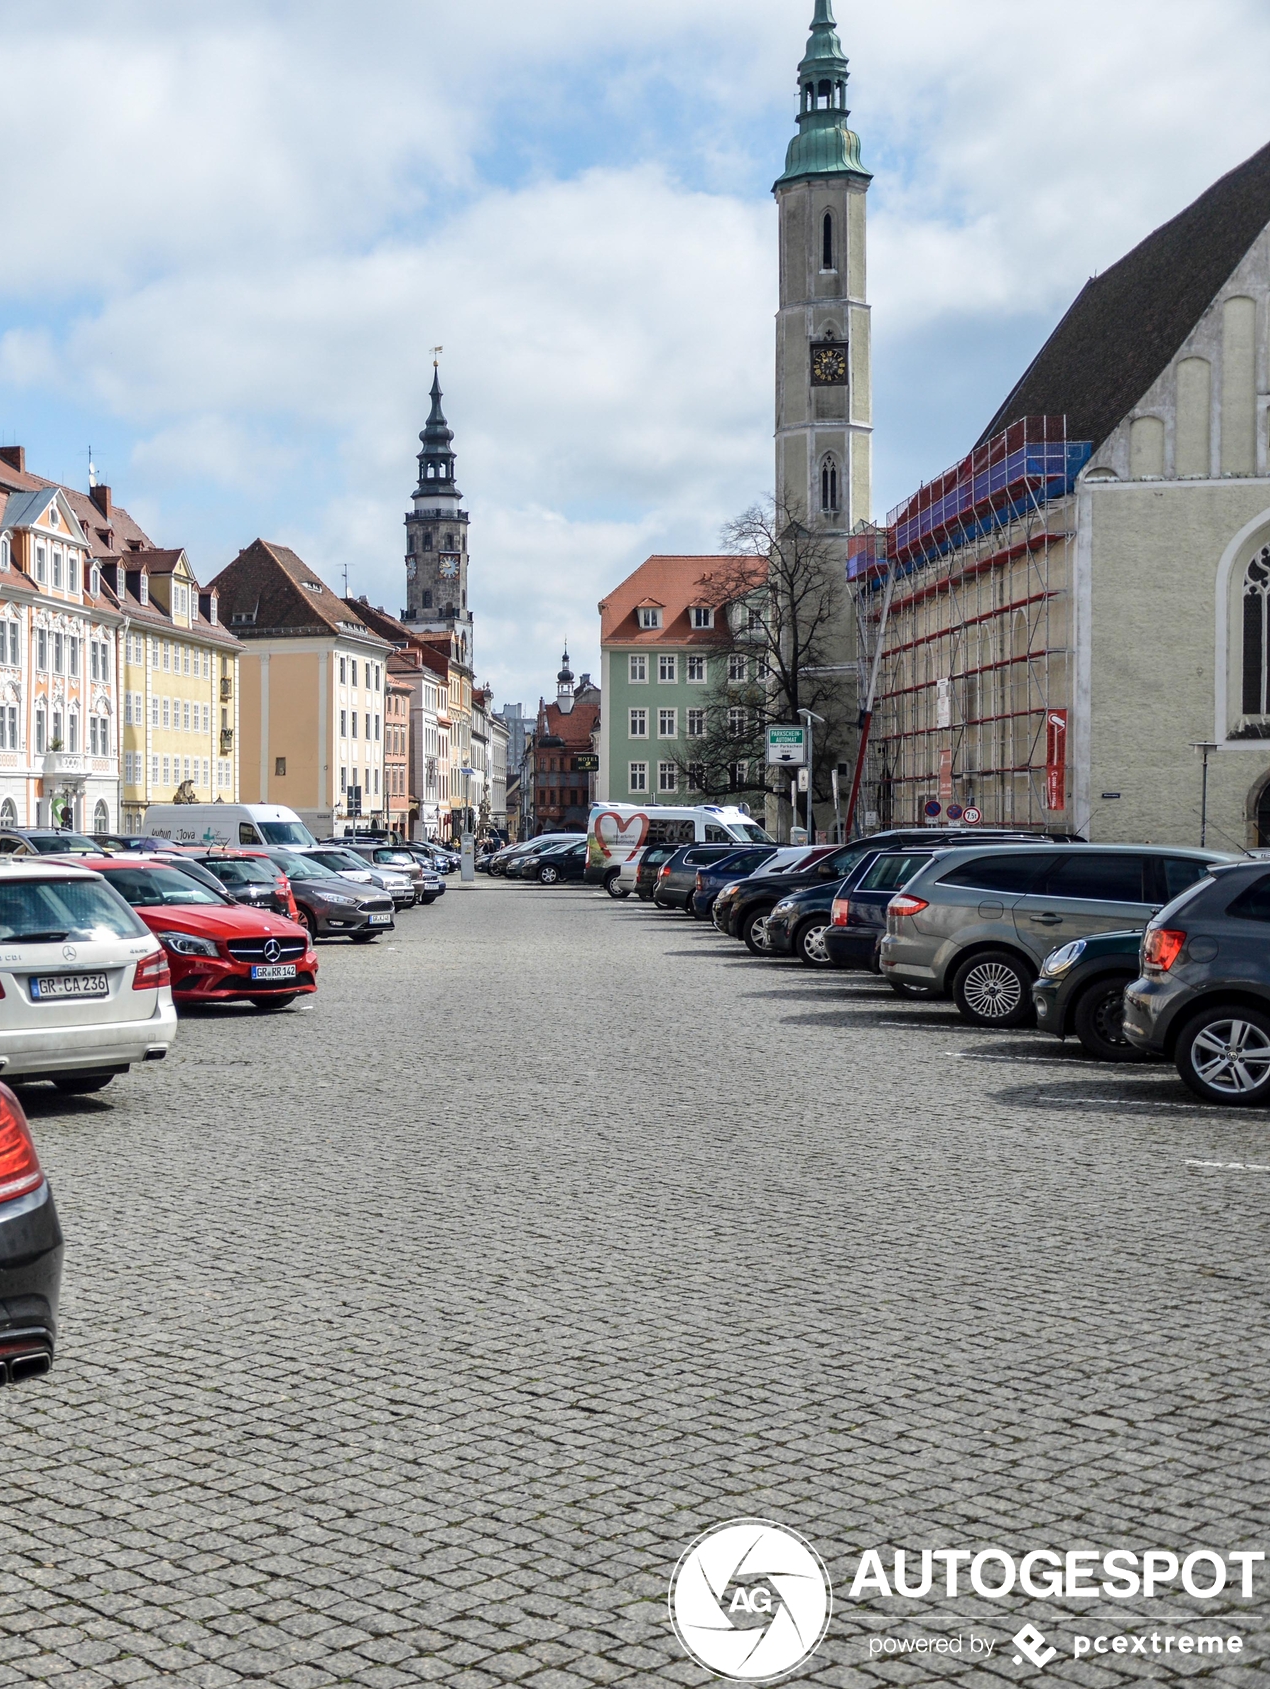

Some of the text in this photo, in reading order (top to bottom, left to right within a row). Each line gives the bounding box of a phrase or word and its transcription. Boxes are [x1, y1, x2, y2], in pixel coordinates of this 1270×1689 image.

[257, 966, 296, 978] GR RR 142
[39, 978, 57, 994] GR
[63, 977, 81, 992] CA
[82, 975, 106, 991] 236
